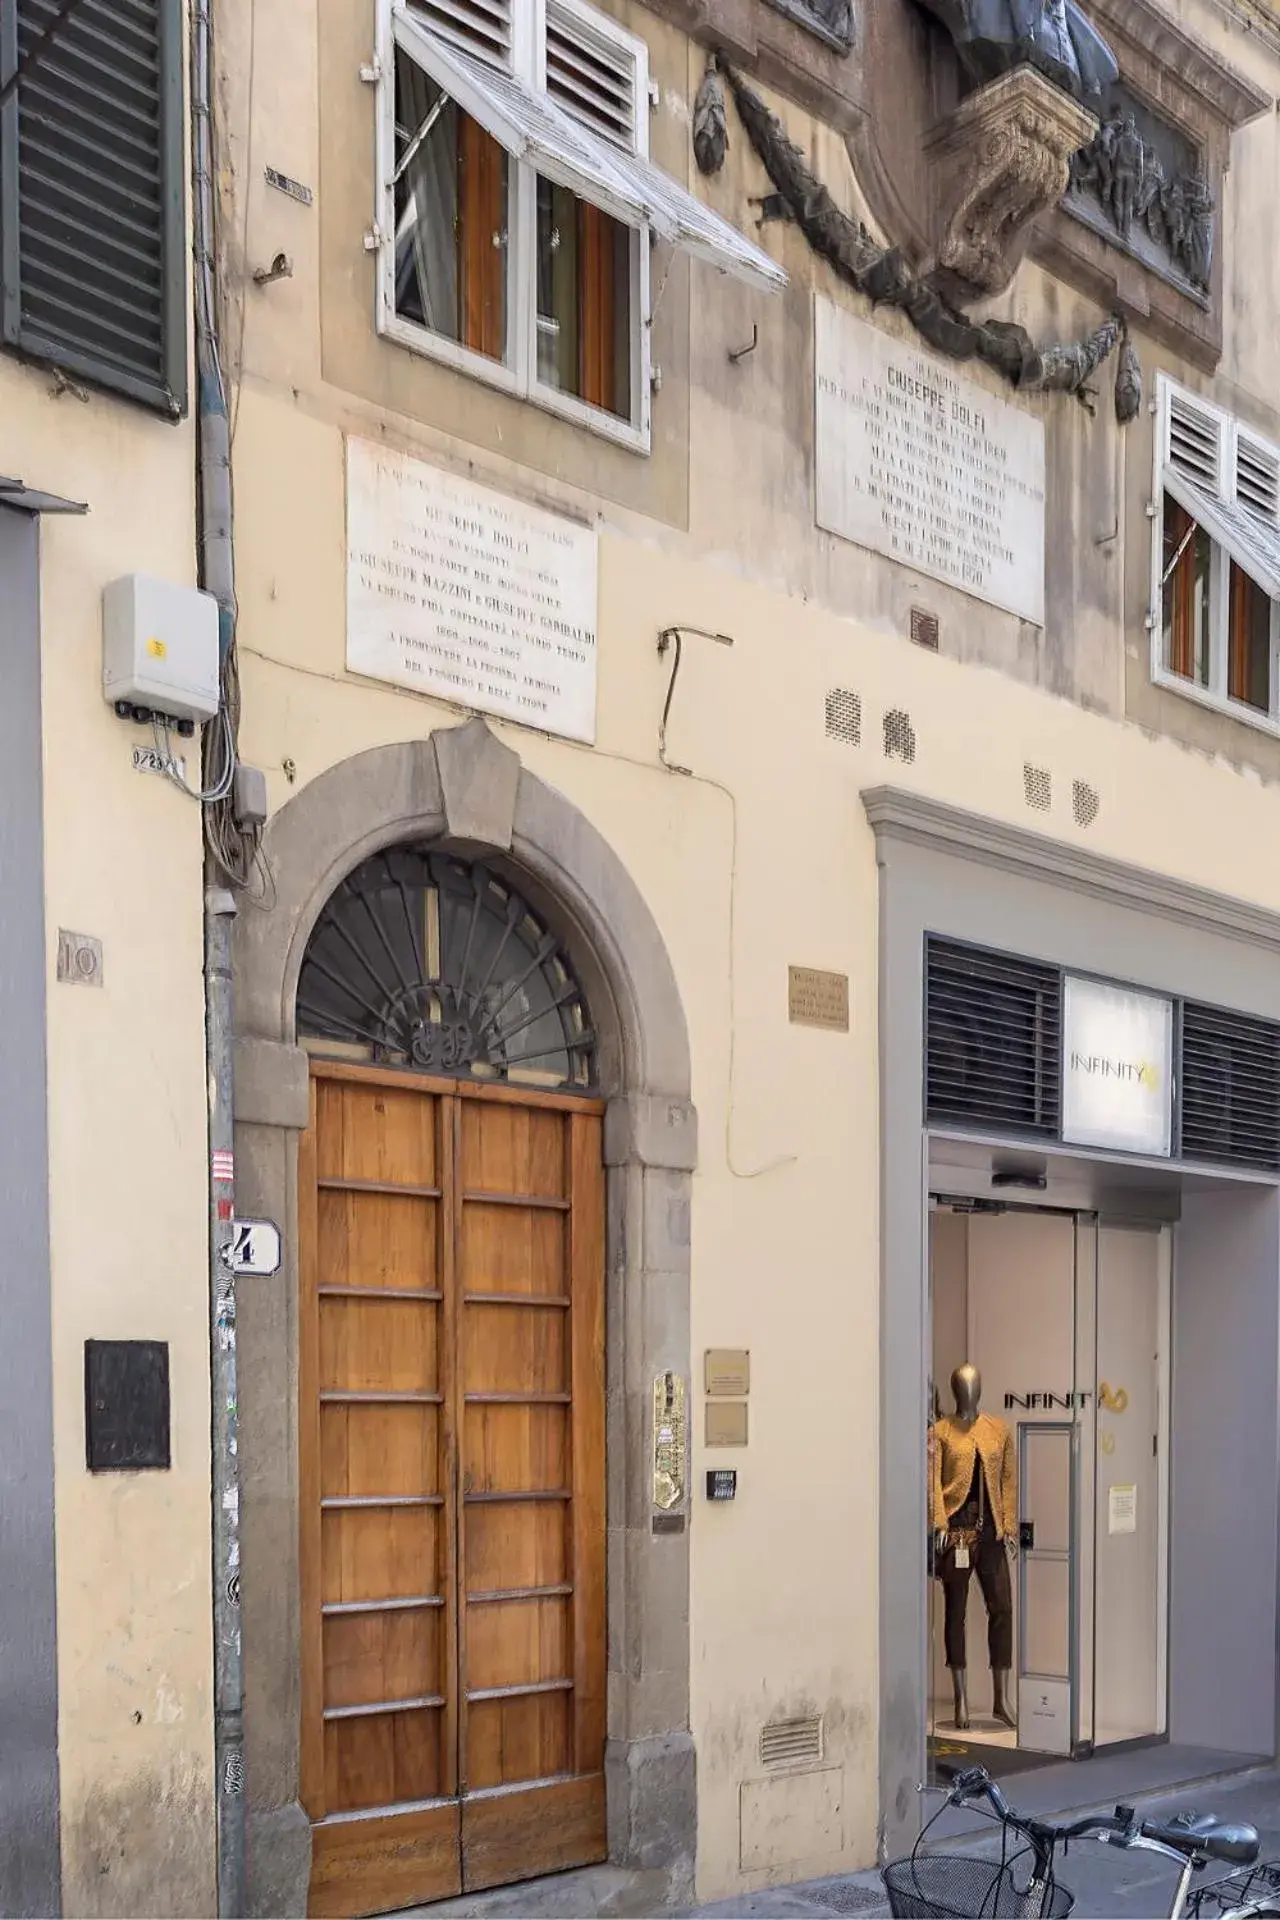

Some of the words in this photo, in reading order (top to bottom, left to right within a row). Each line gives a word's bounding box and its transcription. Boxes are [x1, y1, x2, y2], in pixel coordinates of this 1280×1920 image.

[887, 364, 944, 413] GIUSEPPE
[951, 399, 984, 435] DOLFI
[492, 528, 528, 555] DOLFI
[423, 571, 470, 602] MAZZINI
[484, 594, 535, 625] GIUSEPPE
[539, 613, 595, 646] GARIBALDI
[1070, 1052, 1146, 1083] INFINITY
[233, 1227, 254, 1265] 4
